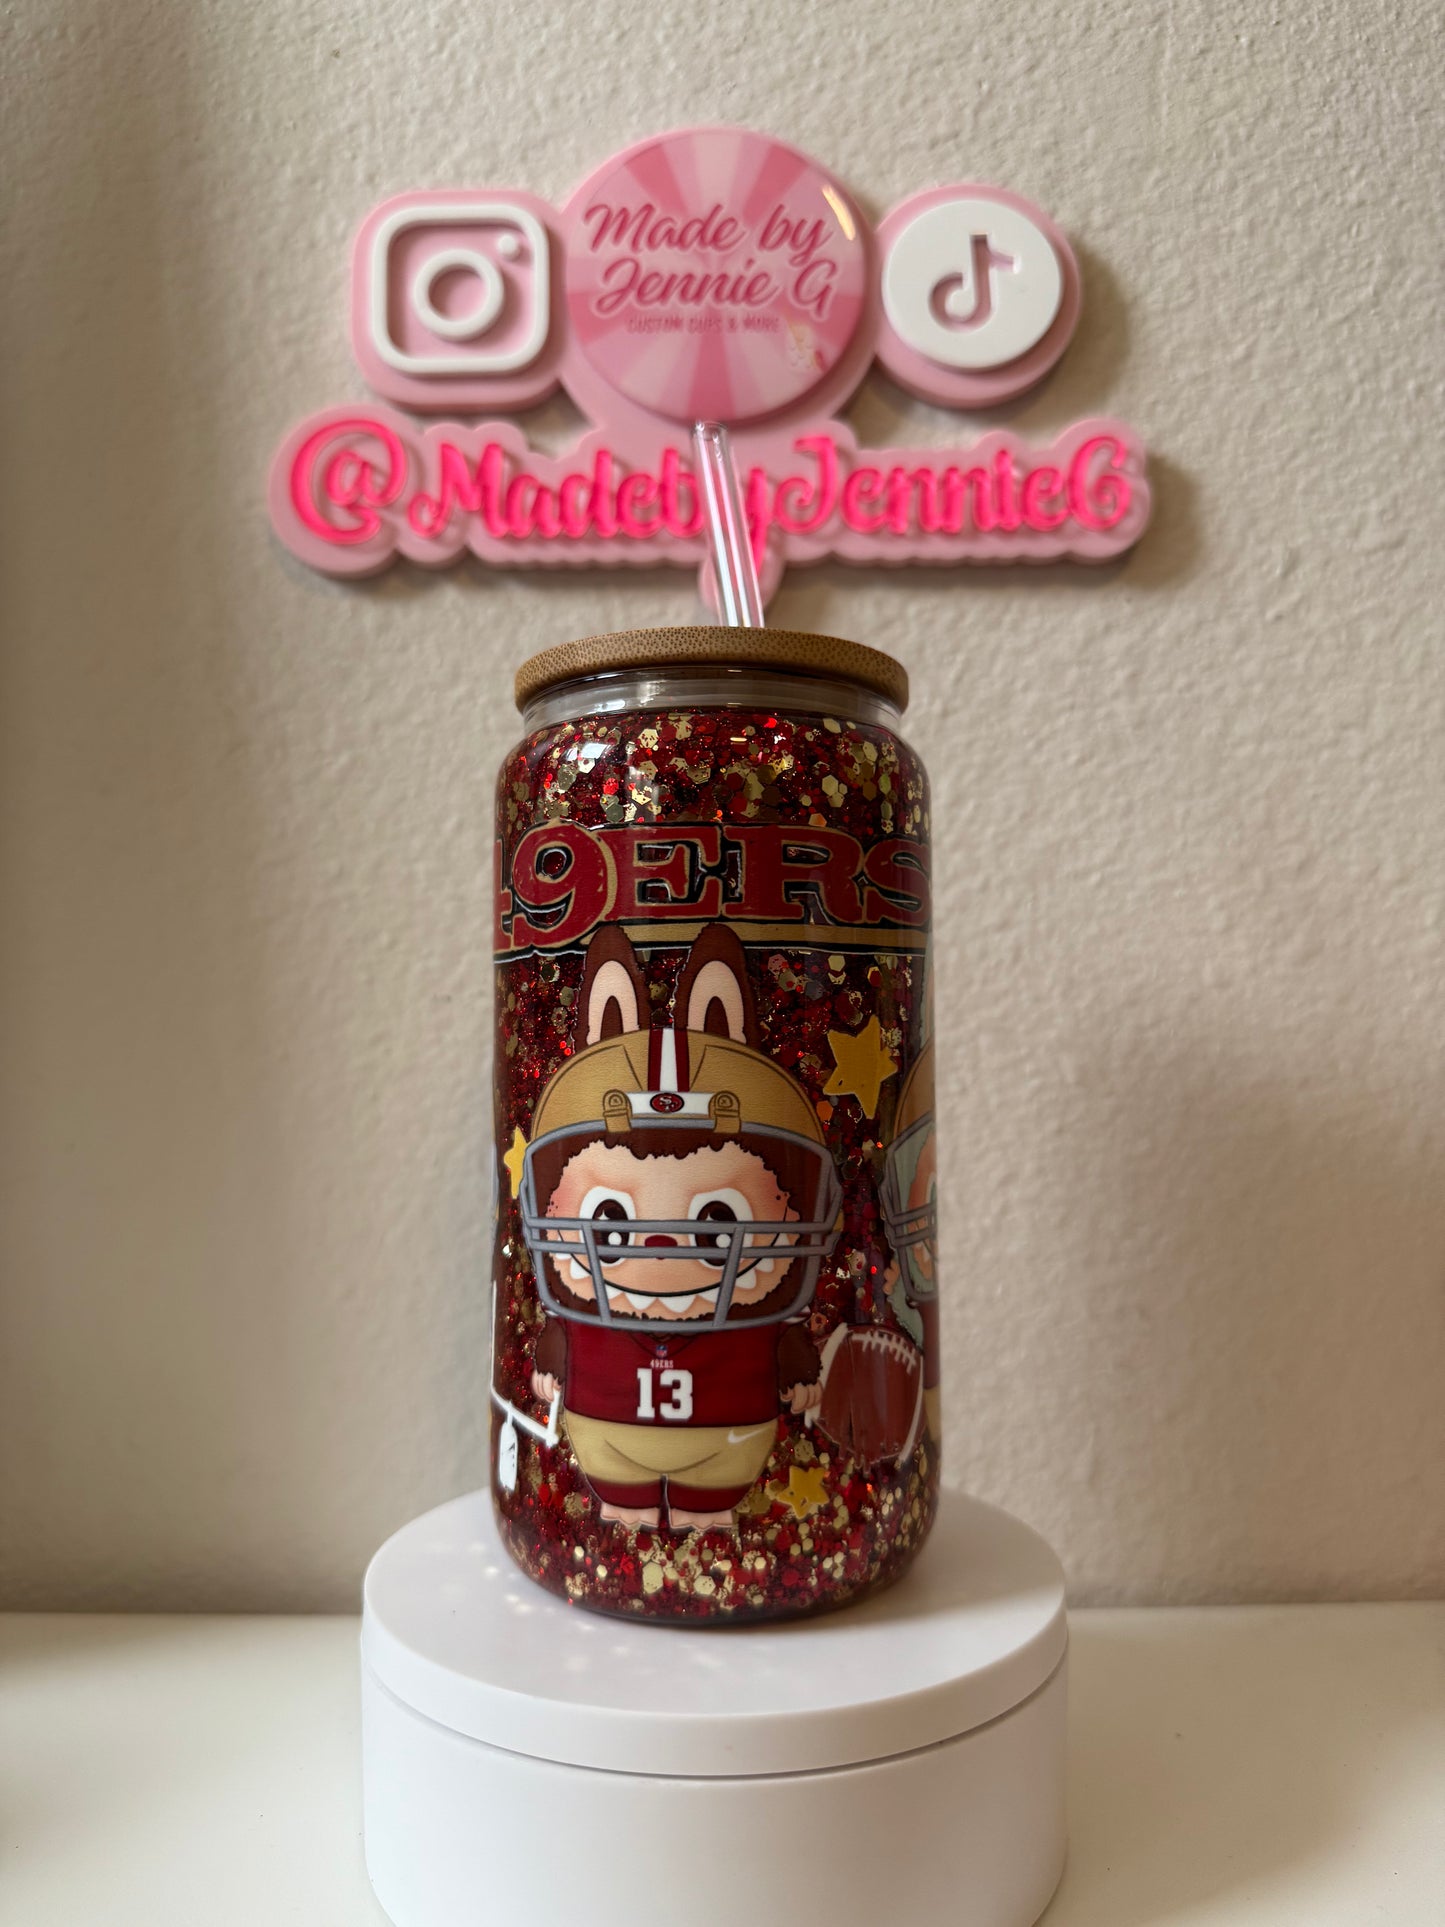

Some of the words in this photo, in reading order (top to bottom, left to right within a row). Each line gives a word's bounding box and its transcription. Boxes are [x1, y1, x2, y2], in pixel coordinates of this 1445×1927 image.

[584, 203, 746, 252] Made
[758, 203, 833, 267] by
[595, 257, 781, 314] Jennie
[793, 258, 837, 317] G
[637, 1367, 693, 1420] 13
